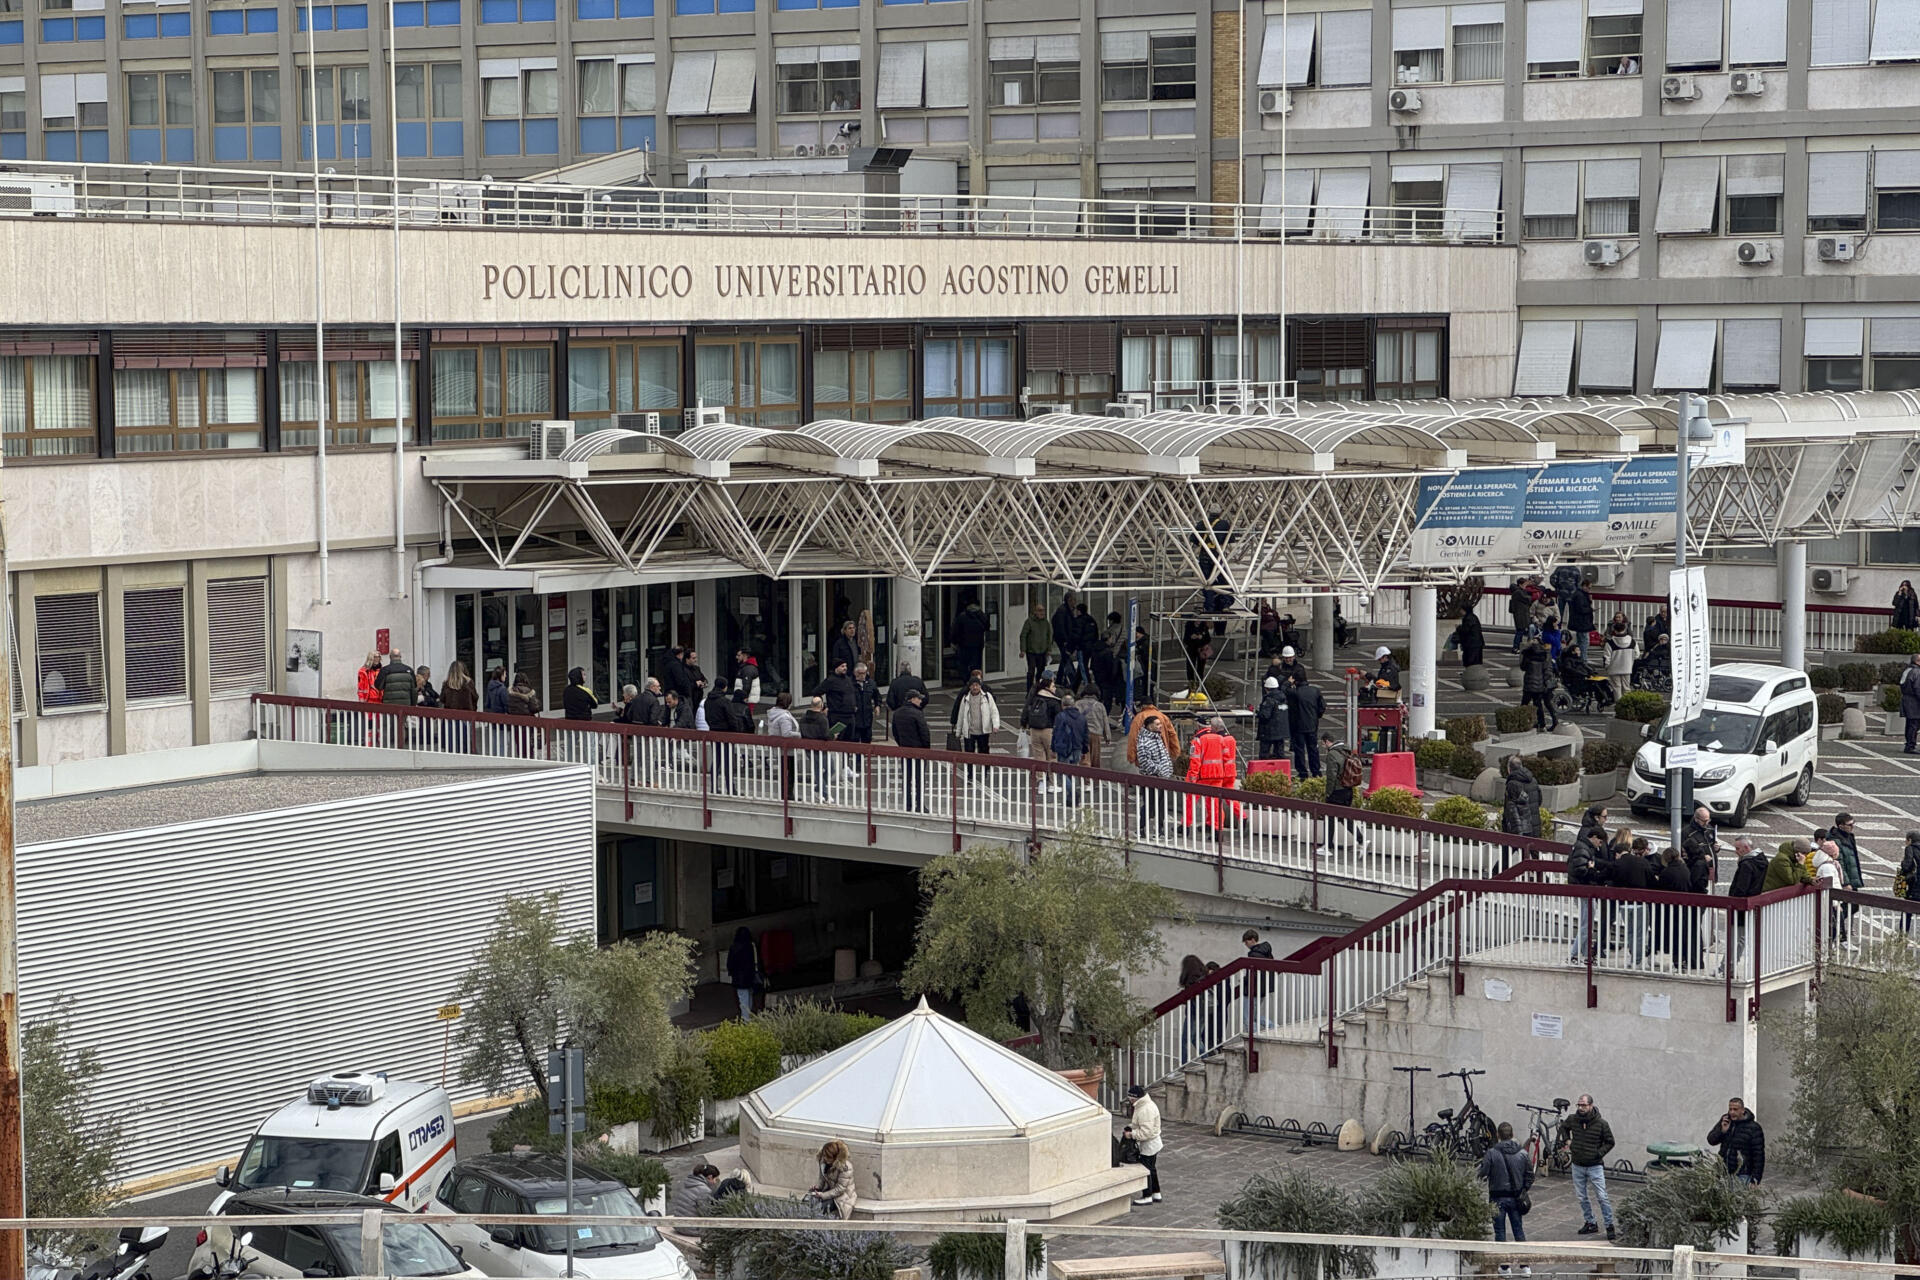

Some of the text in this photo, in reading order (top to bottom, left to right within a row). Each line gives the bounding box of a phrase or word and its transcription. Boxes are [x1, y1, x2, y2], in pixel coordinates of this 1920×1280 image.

[483, 264, 1179, 300] POLICLINICO UNIVERSITARIO AGOSTINO GEMELLI
[1582, 476, 1604, 484] CURA,
[1440, 549, 1471, 559] Gemelli
[1528, 542, 1559, 550] Gemelli
[1674, 632, 1683, 711] Gemelli
[1692, 628, 1701, 707] Gemelli
